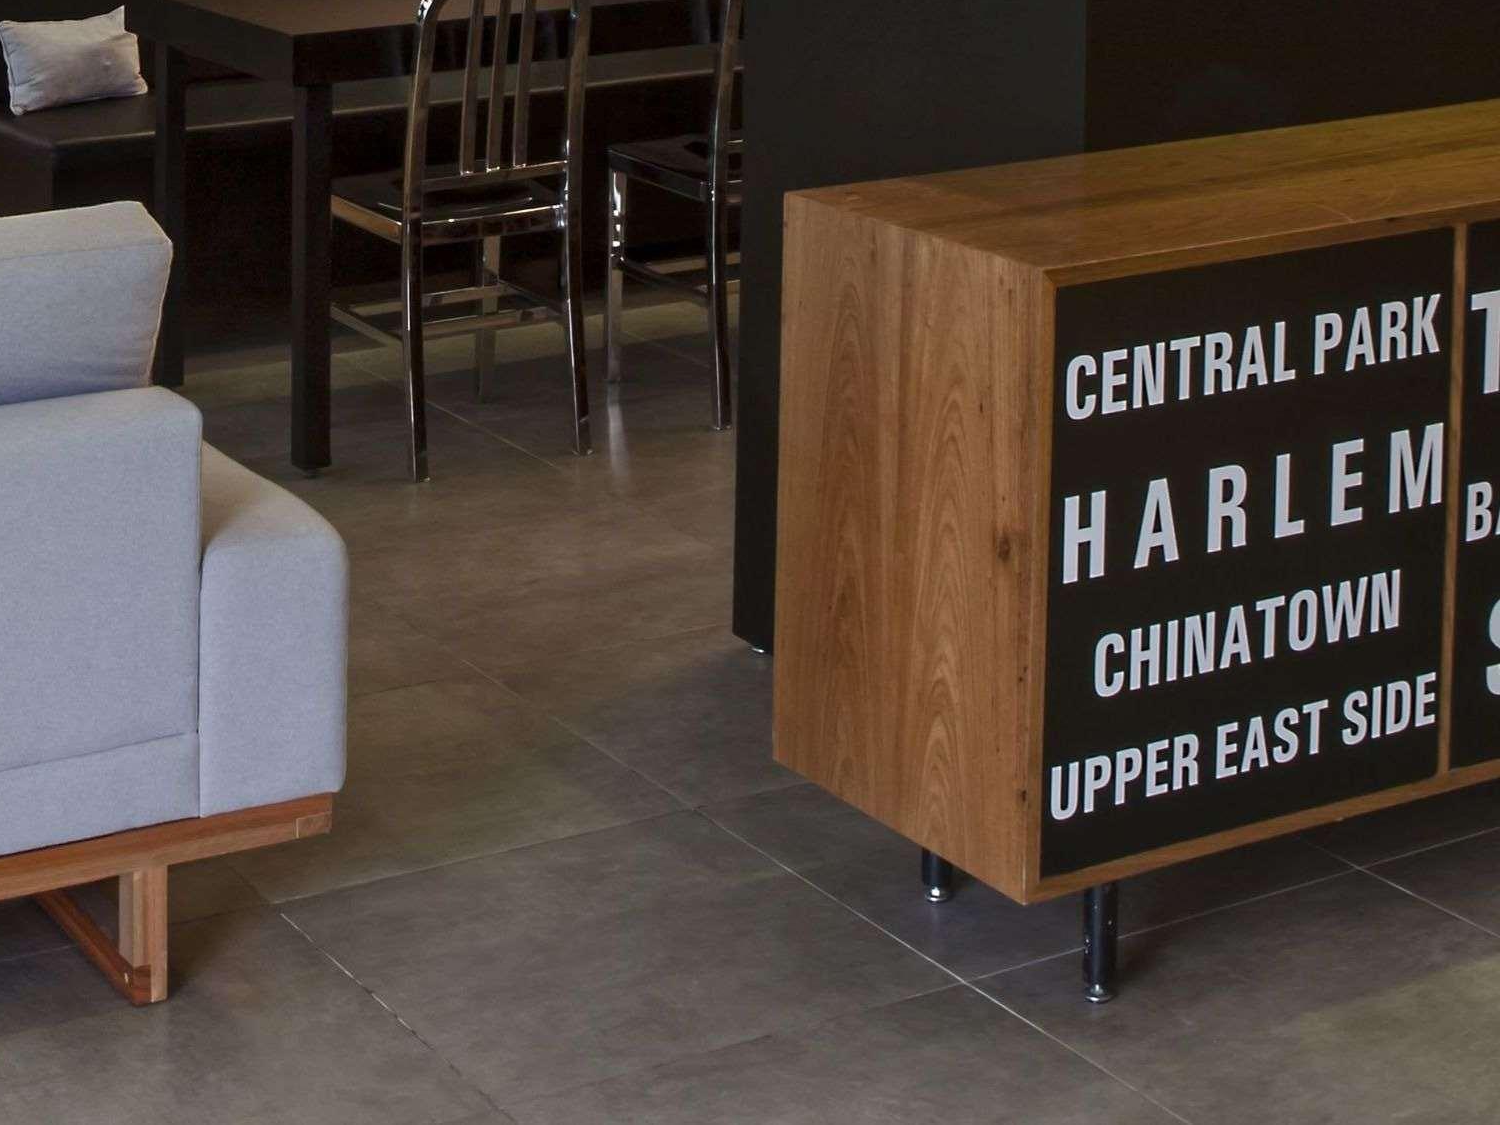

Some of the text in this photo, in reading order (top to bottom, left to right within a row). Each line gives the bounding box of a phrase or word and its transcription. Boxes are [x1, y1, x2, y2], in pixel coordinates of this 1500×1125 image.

[1066, 293, 1441, 420] CENTRAL PARK
[1062, 422, 1445, 585] HARLEM
[1465, 481, 1500, 543] B
[1094, 568, 1401, 698] CHINATOWN
[1050, 671, 1437, 821] UPPER EAST SIDE
